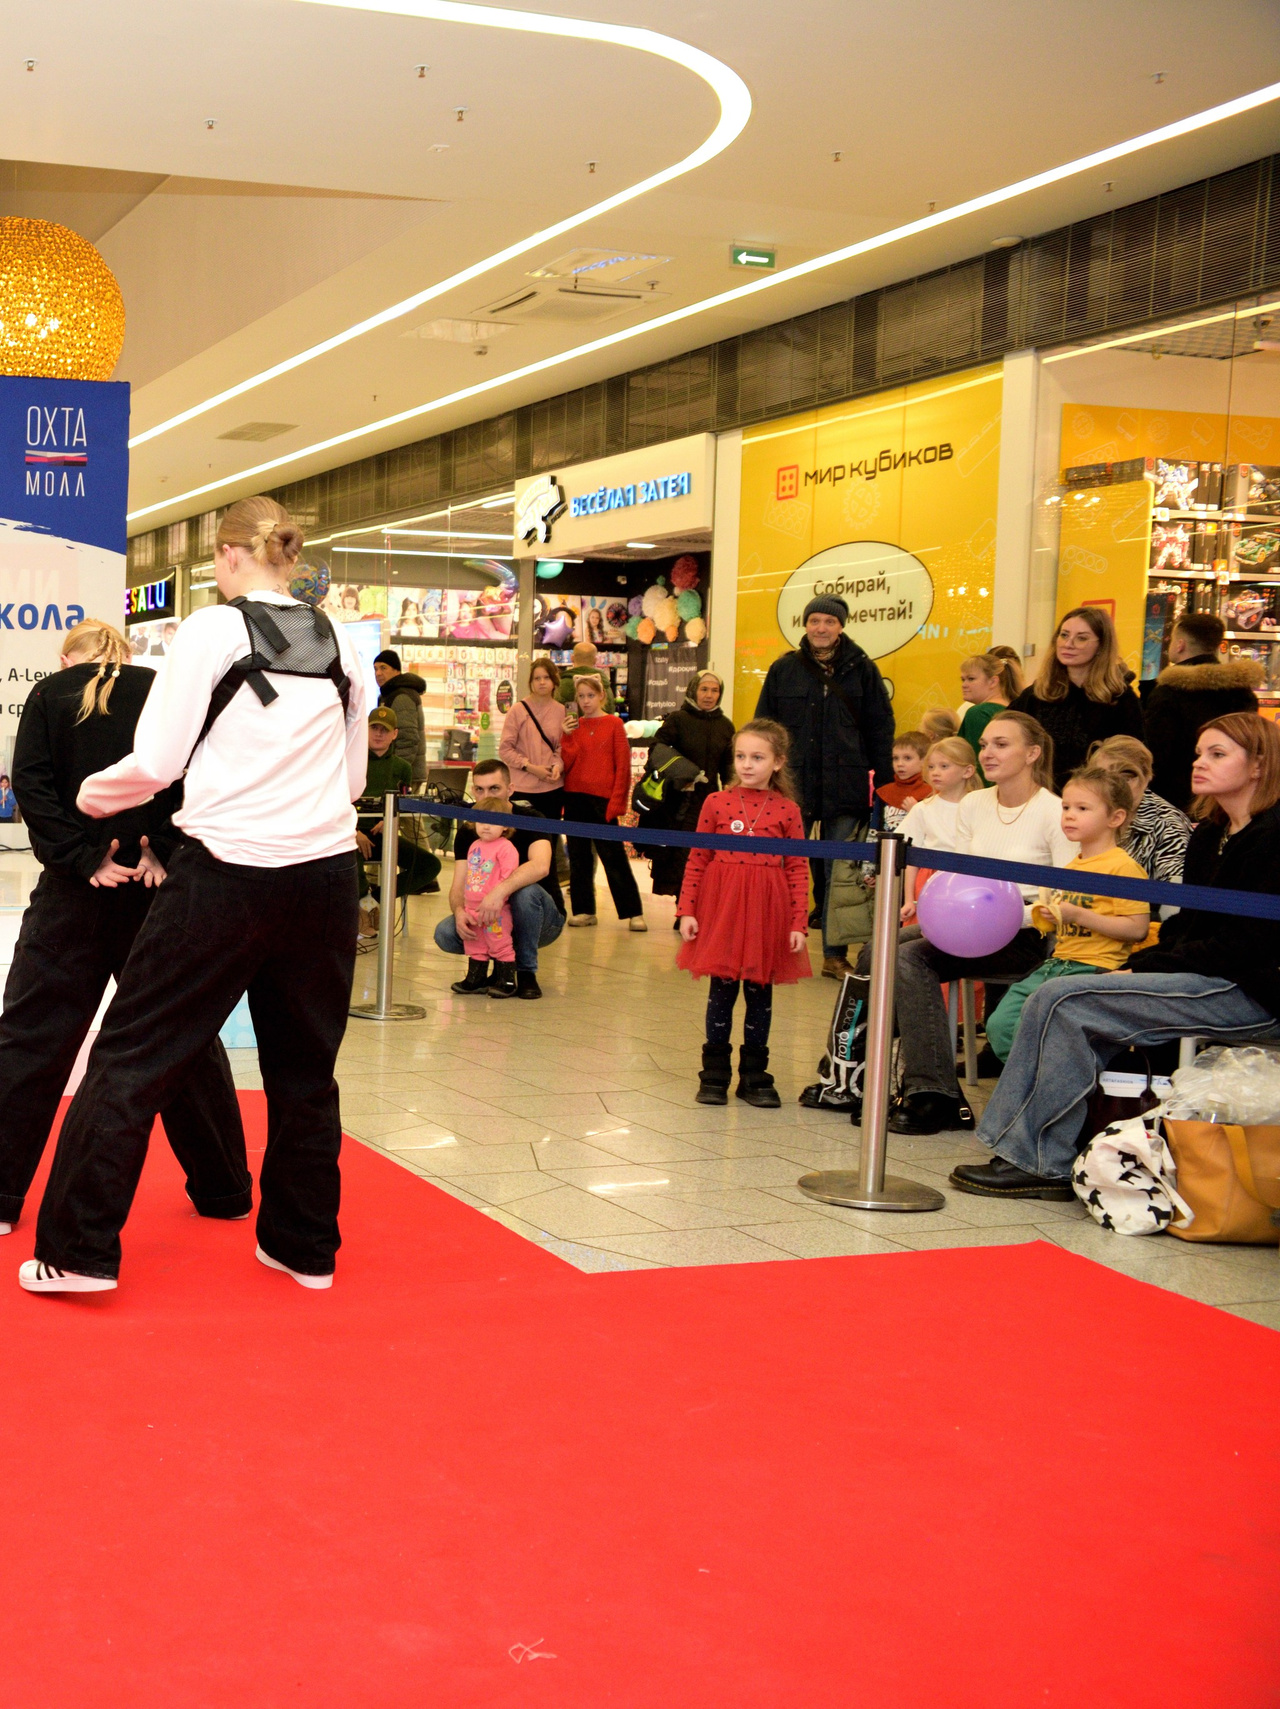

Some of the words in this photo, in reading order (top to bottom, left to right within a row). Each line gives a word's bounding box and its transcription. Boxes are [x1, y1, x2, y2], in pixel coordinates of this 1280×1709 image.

[26, 406, 87, 447] ОХТА
[849, 442, 954, 481] кубиков
[25, 470, 85, 497] МОЛЛ
[570, 484, 637, 518] ВЕСЁЛАЯ
[638, 472, 691, 504] ЗАТЕЯ
[813, 570, 891, 598] Собирай,
[848, 599, 913, 623] мечтай!
